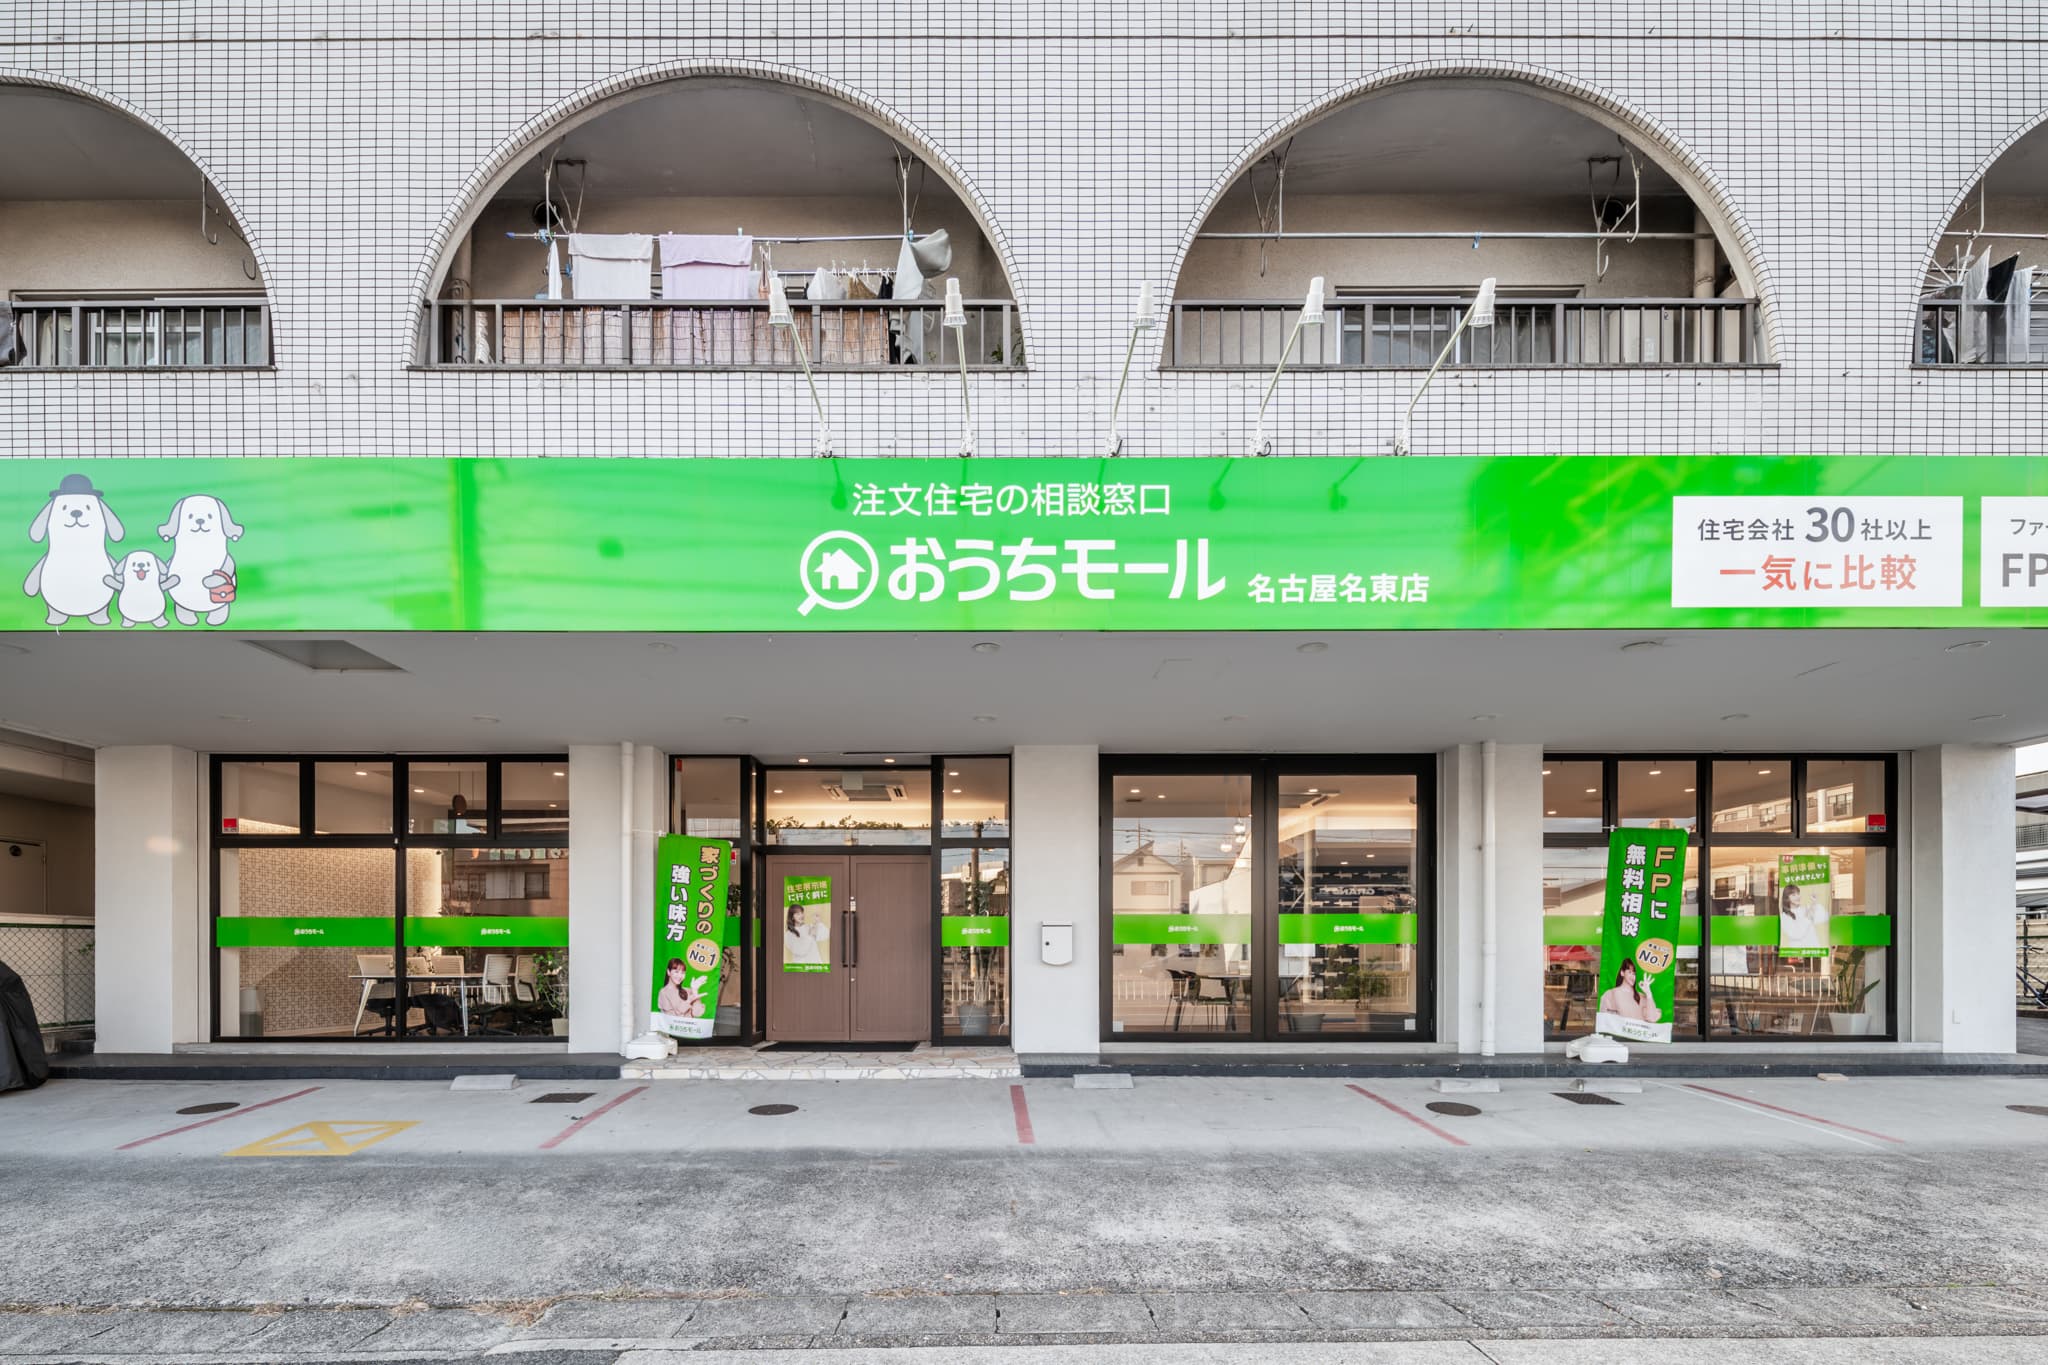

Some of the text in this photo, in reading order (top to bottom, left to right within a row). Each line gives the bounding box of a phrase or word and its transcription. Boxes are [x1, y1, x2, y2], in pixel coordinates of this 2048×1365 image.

[852, 482, 1171, 516] 注文住宅の相談窓口
[1697, 506, 1933, 543] 住宅会社 30 社以上
[2009, 518, 2048, 536] ファ
[887, 537, 1227, 603] おうちモール
[1247, 572, 1430, 604] 名古屋名東店
[1718, 554, 1917, 591] 一気に比較
[666, 864, 691, 941] 強い味方
[696, 846, 720, 934] 家づくりの
[1621, 844, 1646, 937] 無料相談
